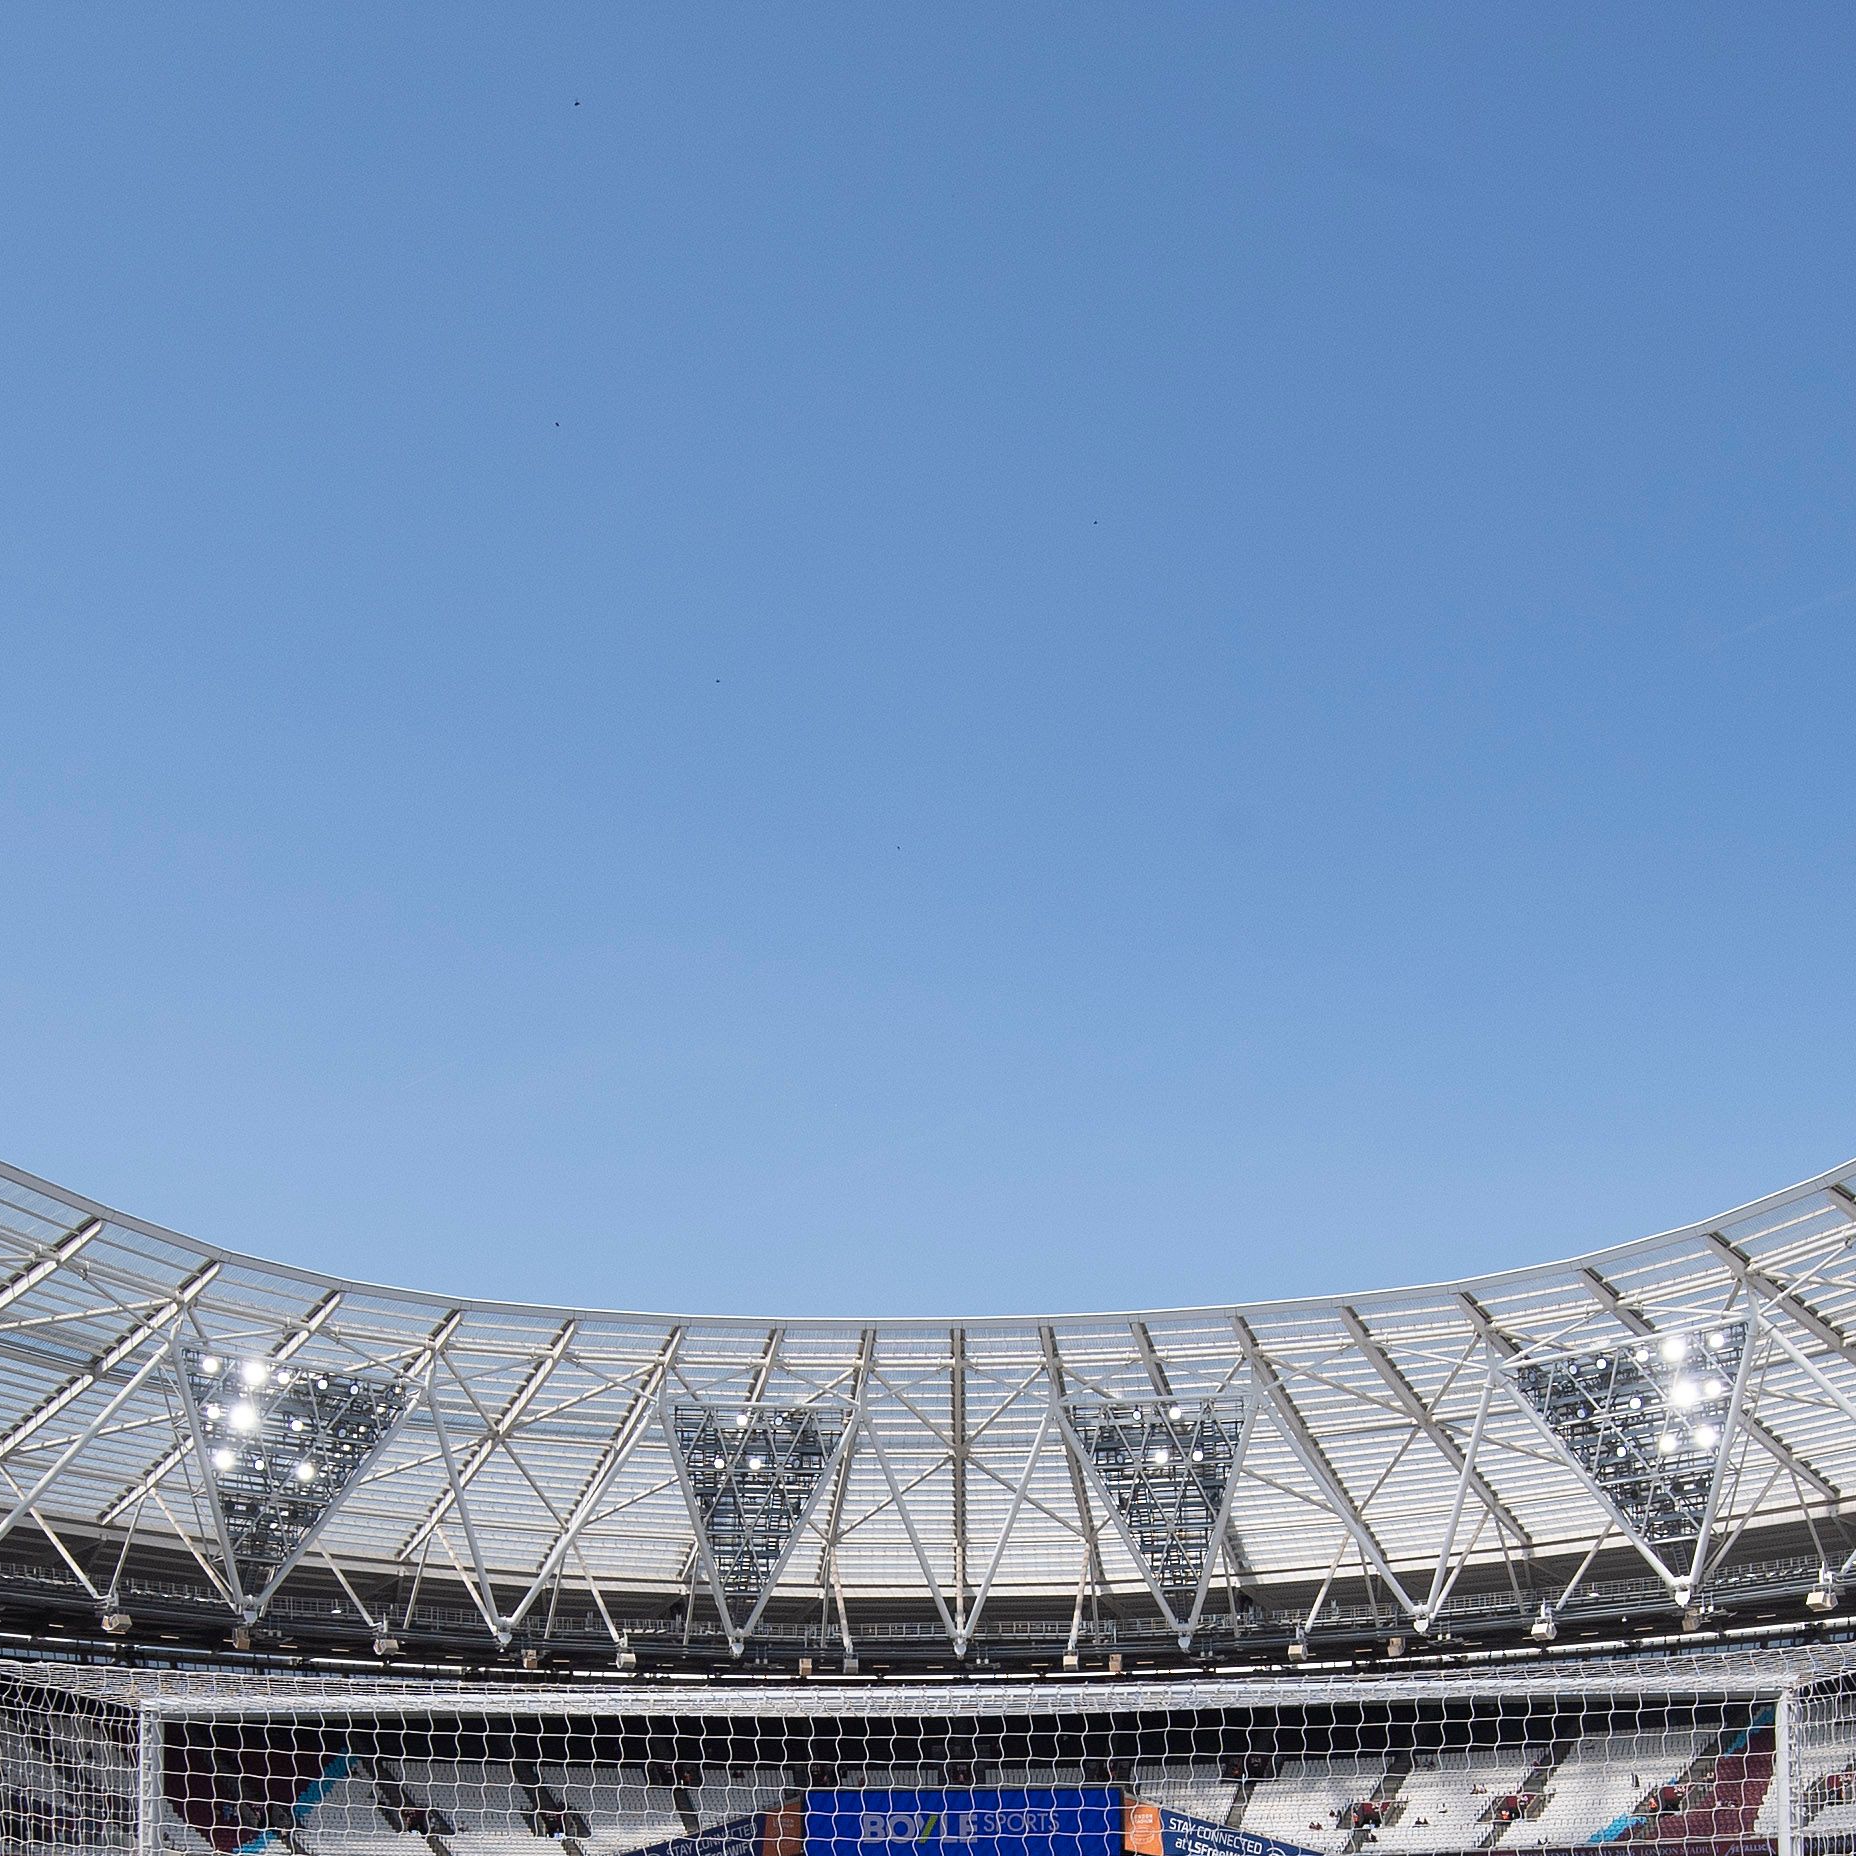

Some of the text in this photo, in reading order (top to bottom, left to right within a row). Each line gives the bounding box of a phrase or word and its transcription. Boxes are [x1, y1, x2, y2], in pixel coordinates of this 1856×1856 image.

[863, 1812, 1060, 1843] BOYLE SPORTS
[1168, 1817, 1263, 1855] STAY CONNECTED
[1175, 1837, 1187, 1850] at
[1640, 1847, 1680, 1856] LONDON
